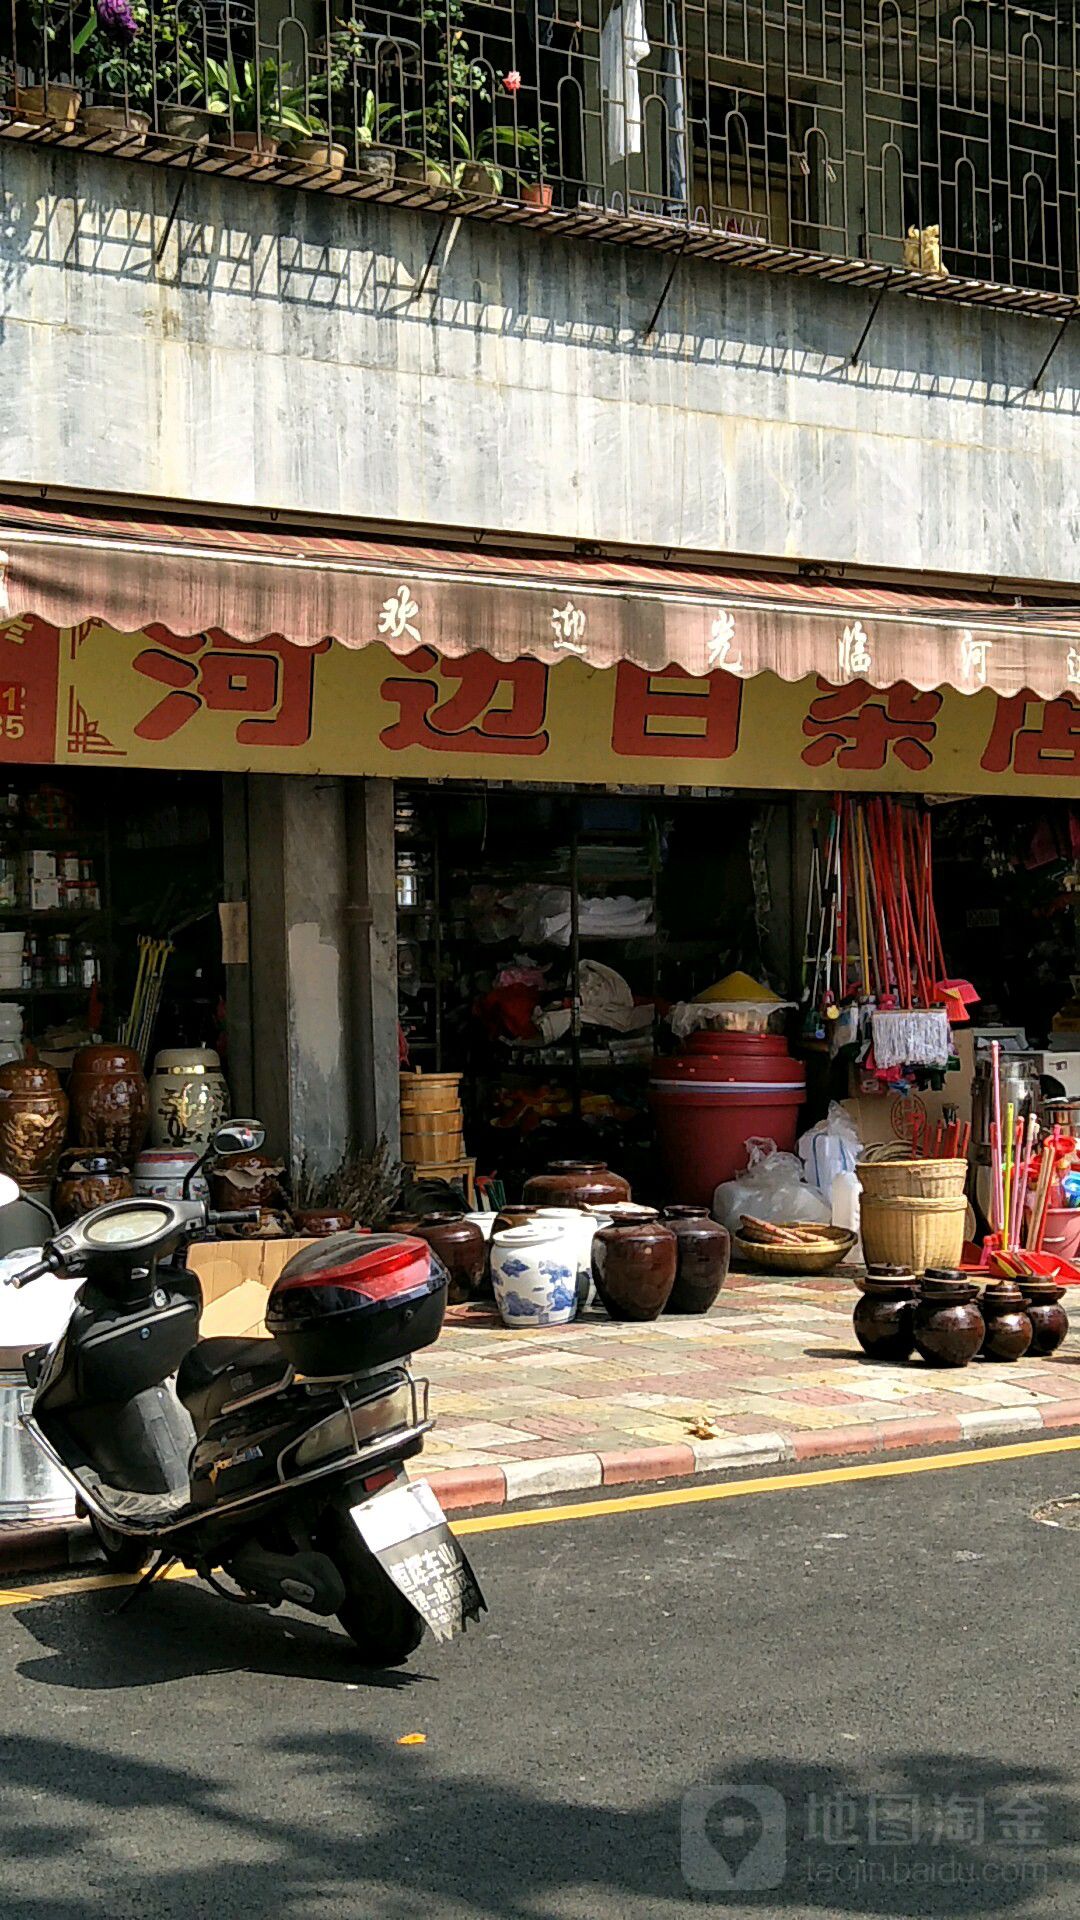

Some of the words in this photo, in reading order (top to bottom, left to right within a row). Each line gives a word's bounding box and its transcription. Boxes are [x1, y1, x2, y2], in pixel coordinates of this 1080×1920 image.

[132, 632, 1080, 776] 河边日杂店
